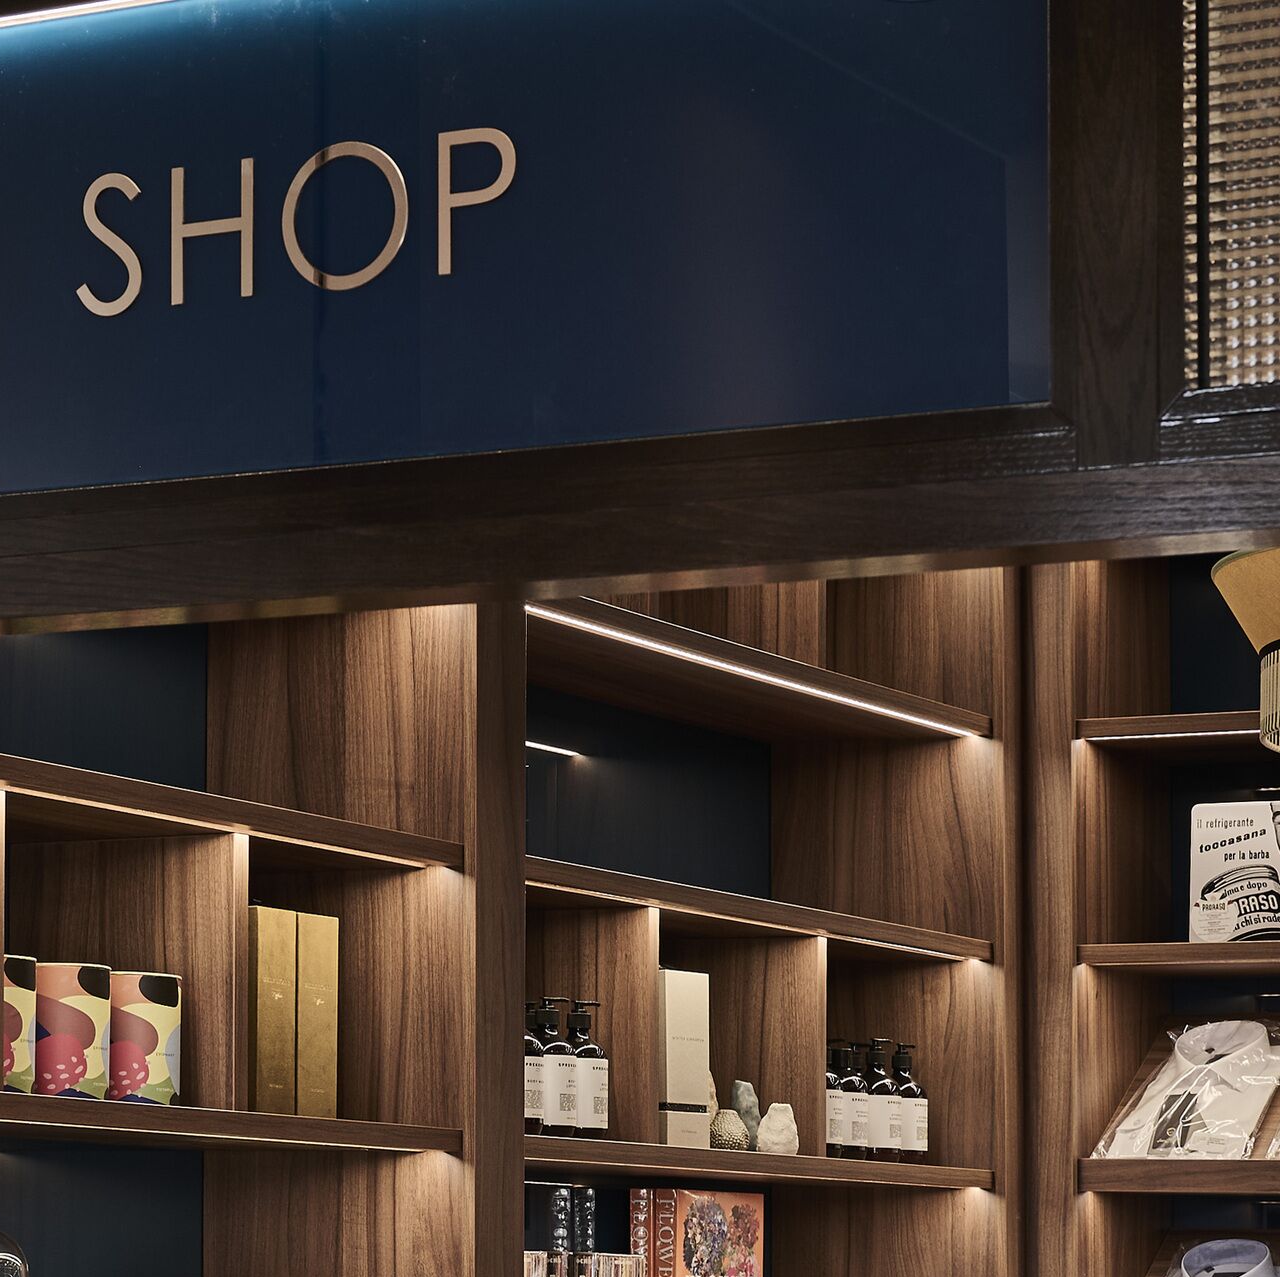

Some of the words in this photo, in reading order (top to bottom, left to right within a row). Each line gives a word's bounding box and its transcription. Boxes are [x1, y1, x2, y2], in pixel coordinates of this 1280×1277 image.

[75, 127, 518, 318] SHOP
[1196, 818, 1202, 829] il
[1206, 817, 1254, 829] refrigerante
[1199, 828, 1267, 853] toccasana
[1224, 851, 1235, 862] per
[1238, 850, 1246, 860] la
[1249, 850, 1270, 860] barba
[1247, 881, 1268, 891] dopo
[1237, 894, 1280, 914] RASO
[1241, 915, 1254, 928] chi
[1253, 913, 1262, 924] si
